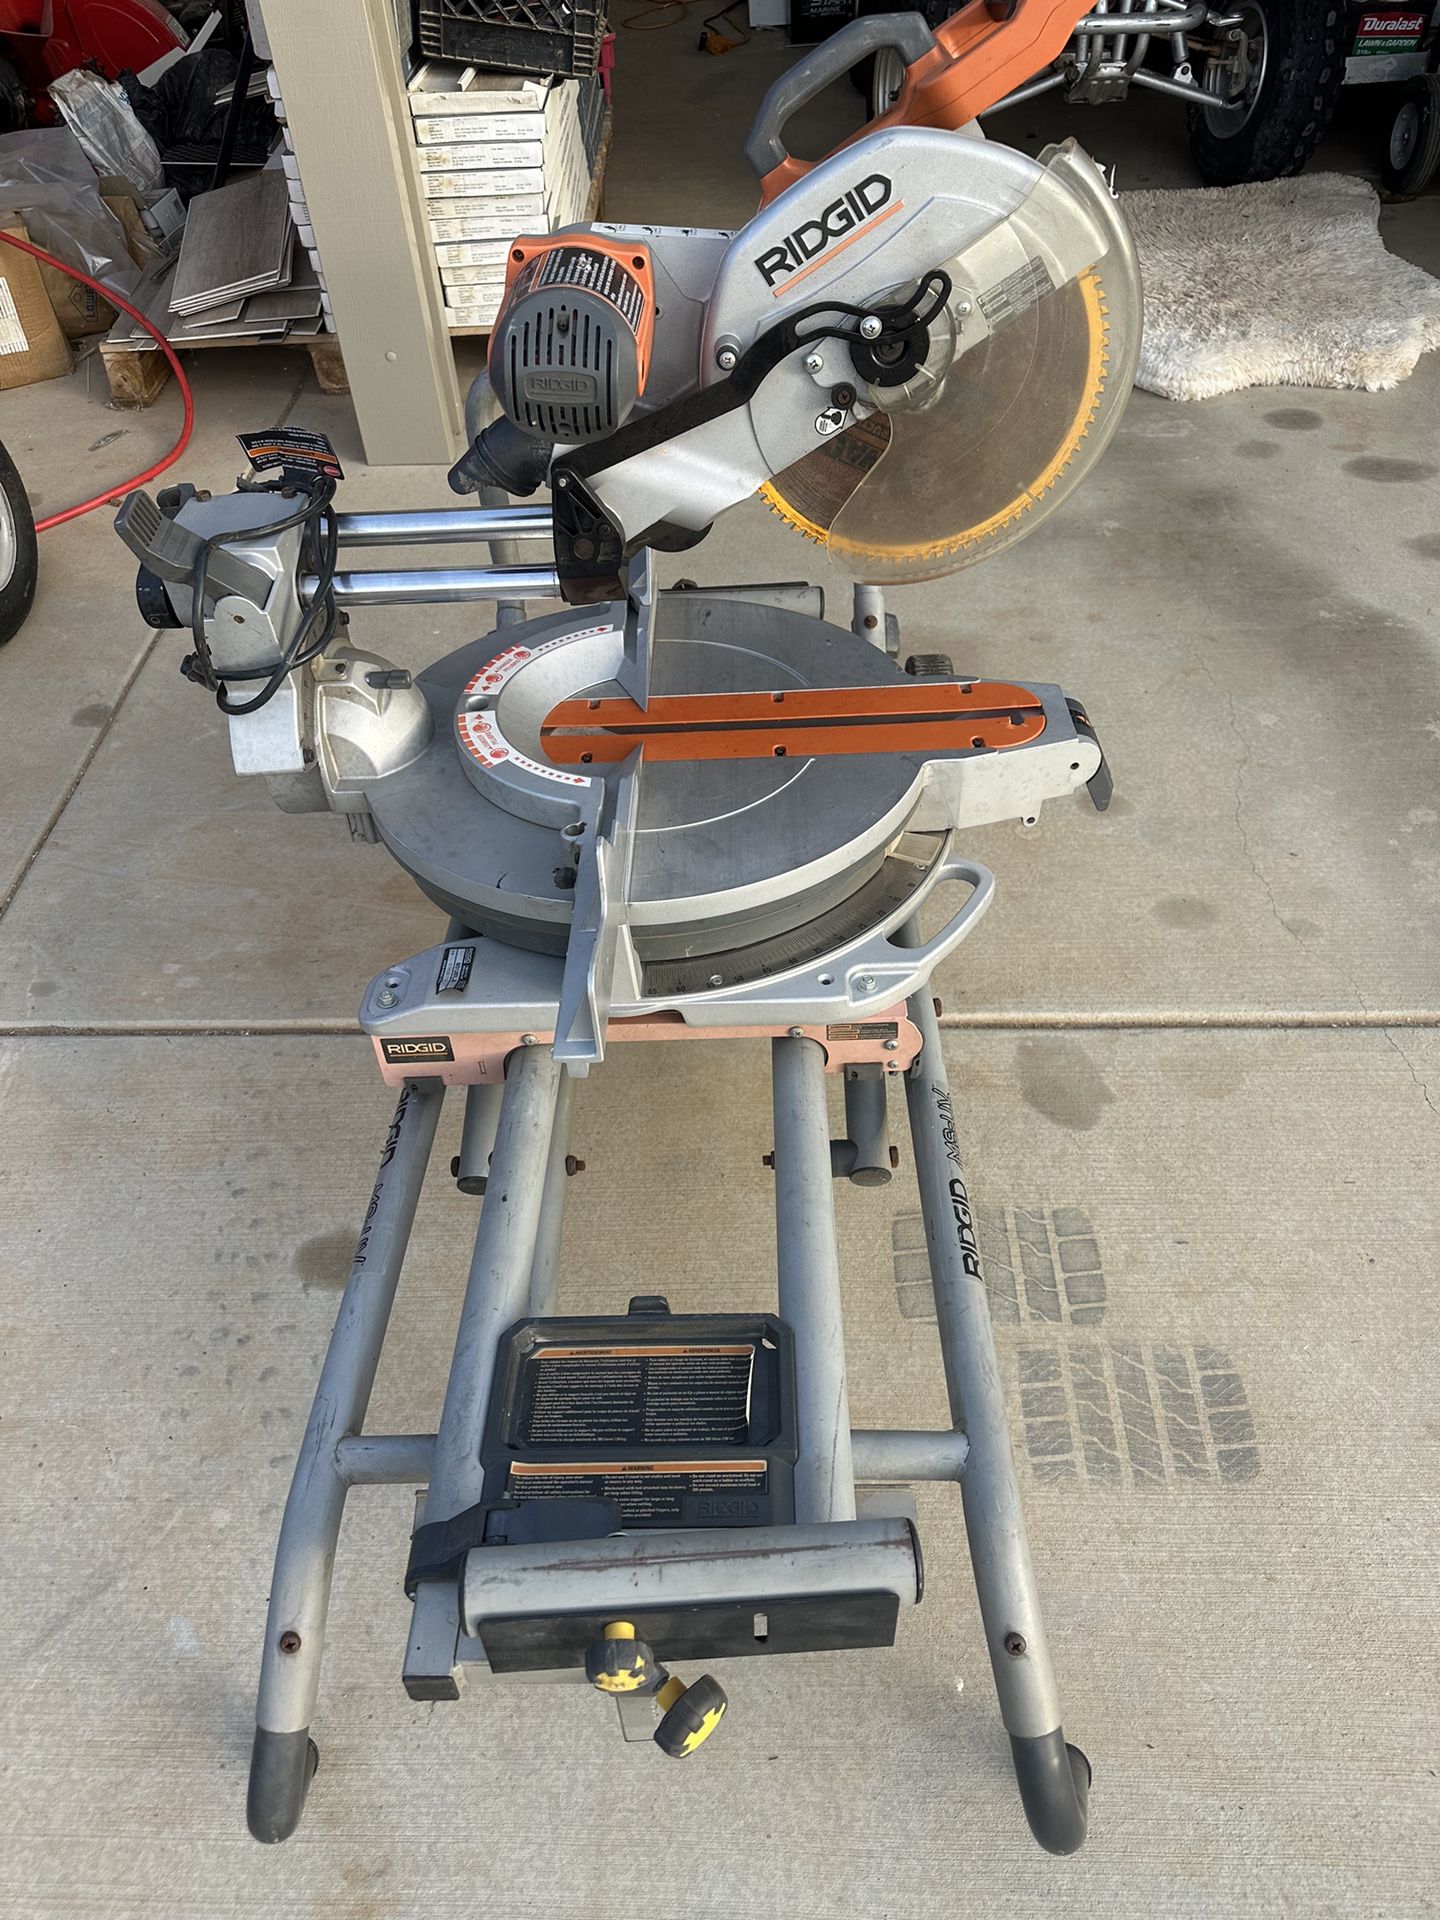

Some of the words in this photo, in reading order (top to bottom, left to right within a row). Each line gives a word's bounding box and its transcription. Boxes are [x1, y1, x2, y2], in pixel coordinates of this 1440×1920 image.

[1364, 17, 1423, 30] Duralast
[754, 174, 892, 287] RIDGID
[86, 287, 94, 318] LOWE
[531, 377, 588, 392] RIDGID
[387, 1042, 446, 1054] RIDGID
[950, 1178, 983, 1282] RIDGID
[696, 1502, 758, 1515] RIDGID
